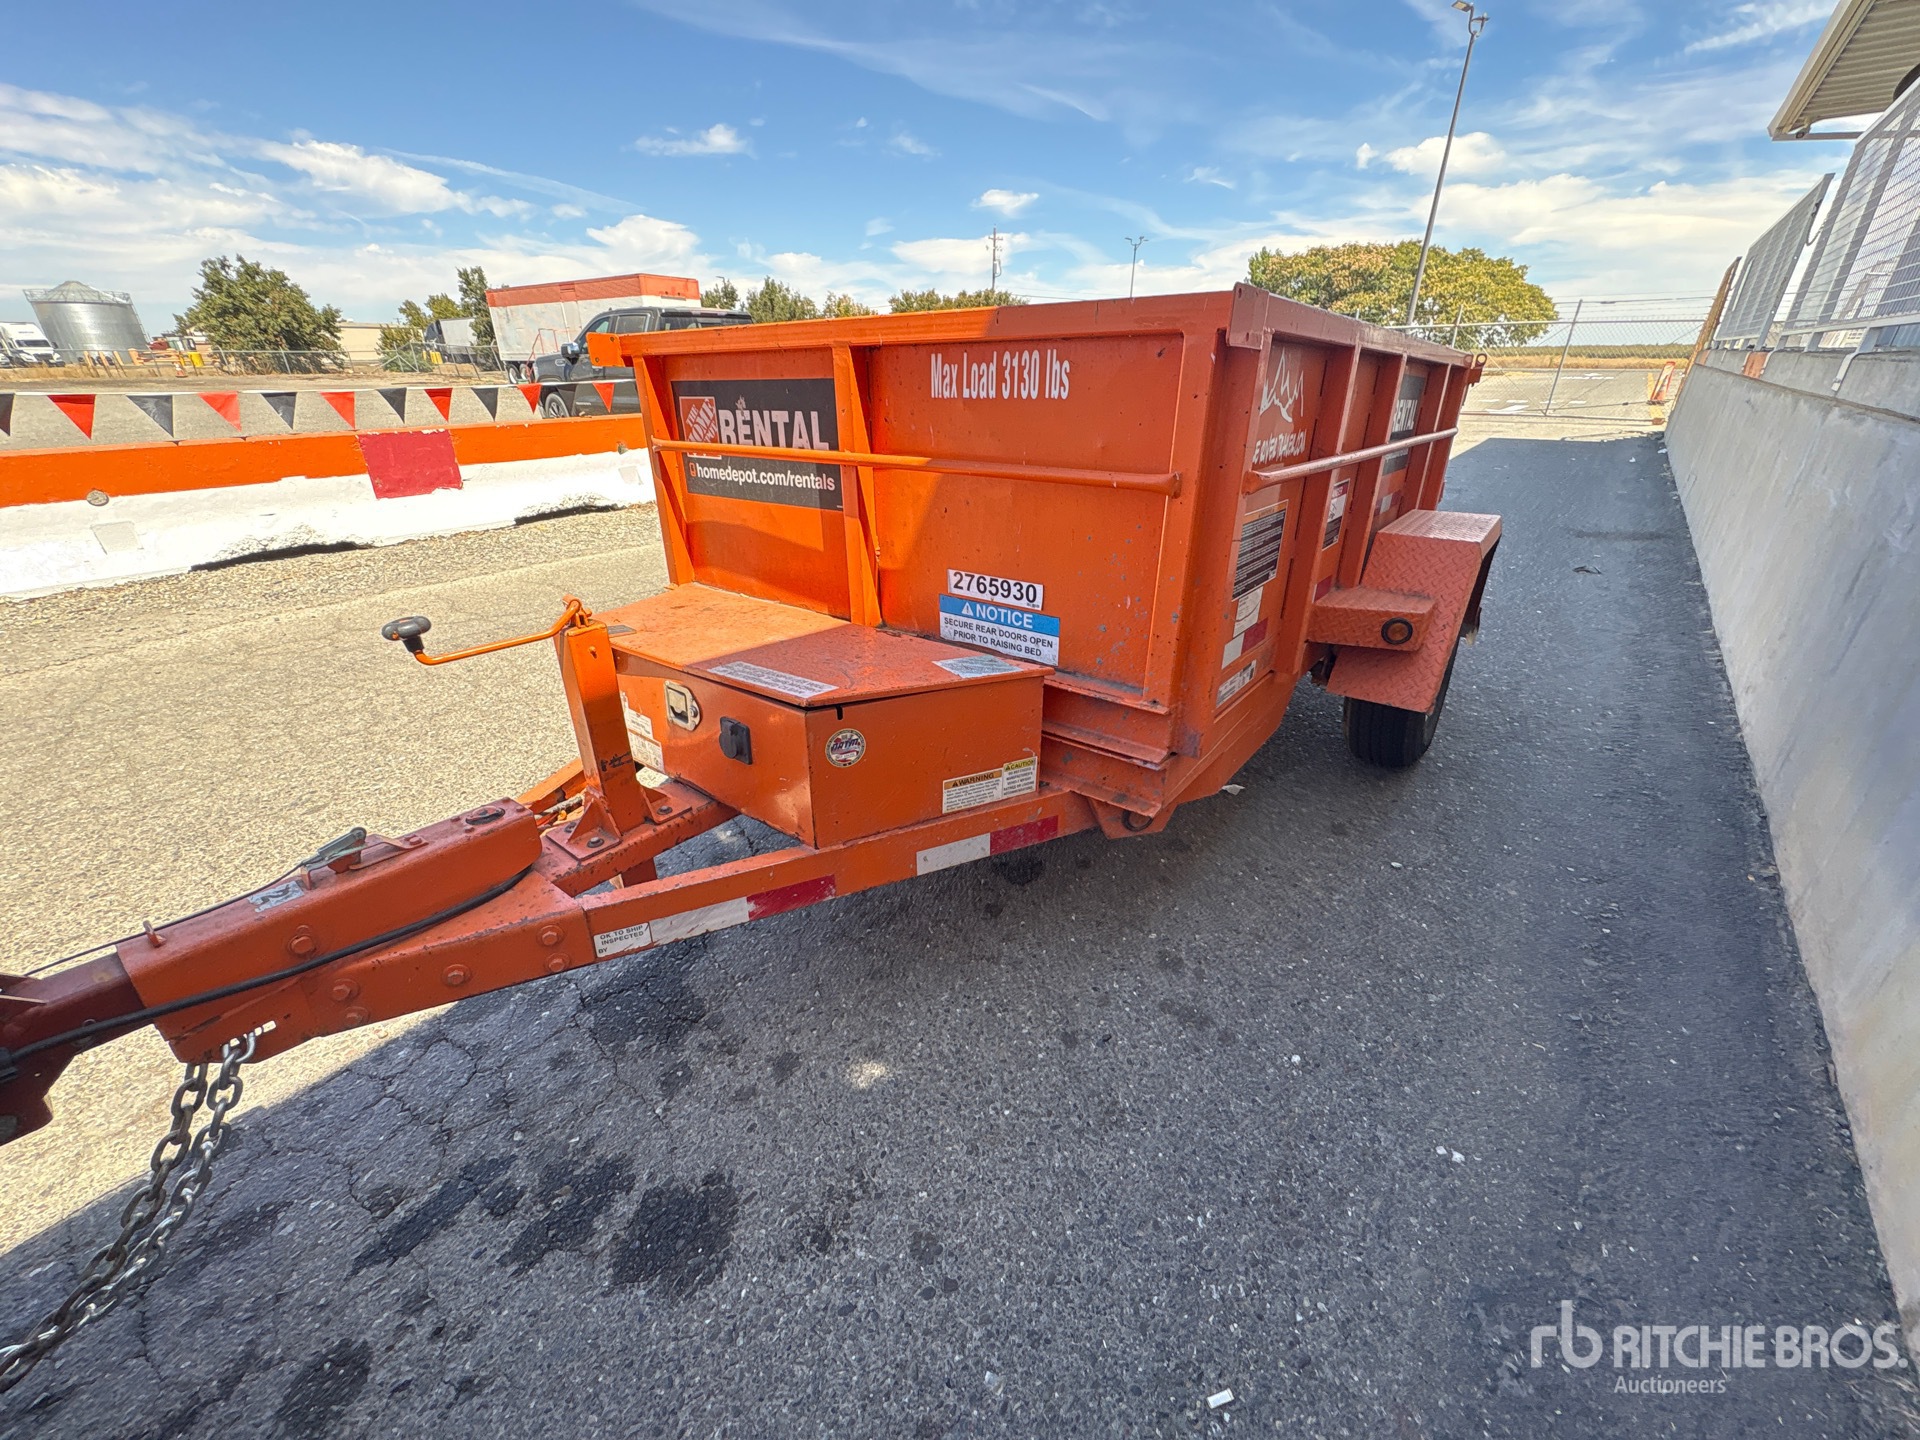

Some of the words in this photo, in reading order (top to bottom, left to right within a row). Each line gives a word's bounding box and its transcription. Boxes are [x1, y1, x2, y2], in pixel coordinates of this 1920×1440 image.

[931, 353, 957, 398] Max
[963, 351, 997, 399] Load
[1002, 350, 1040, 399] 3130
[1045, 349, 1070, 400] lbs
[685, 403, 699, 427] THE
[718, 409, 829, 450] RENTAL
[697, 464, 835, 491] homedepot.com/rentals
[953, 572, 1037, 603] 2765930
[976, 603, 1033, 629] NOTICE
[944, 617, 973, 630] SECURE
[975, 623, 996, 635] REAR
[999, 629, 1028, 642] DOORS
[1030, 636, 1053, 648] OPEN
[953, 630, 976, 641] PRIOR
[978, 635, 989, 644] TO
[990, 637, 1022, 652] RAISING
[1024, 646, 1042, 656] BED
[959, 772, 995, 786] WARNING
[601, 932, 643, 945] INSPECTED
[626, 925, 643, 933] SHIP
